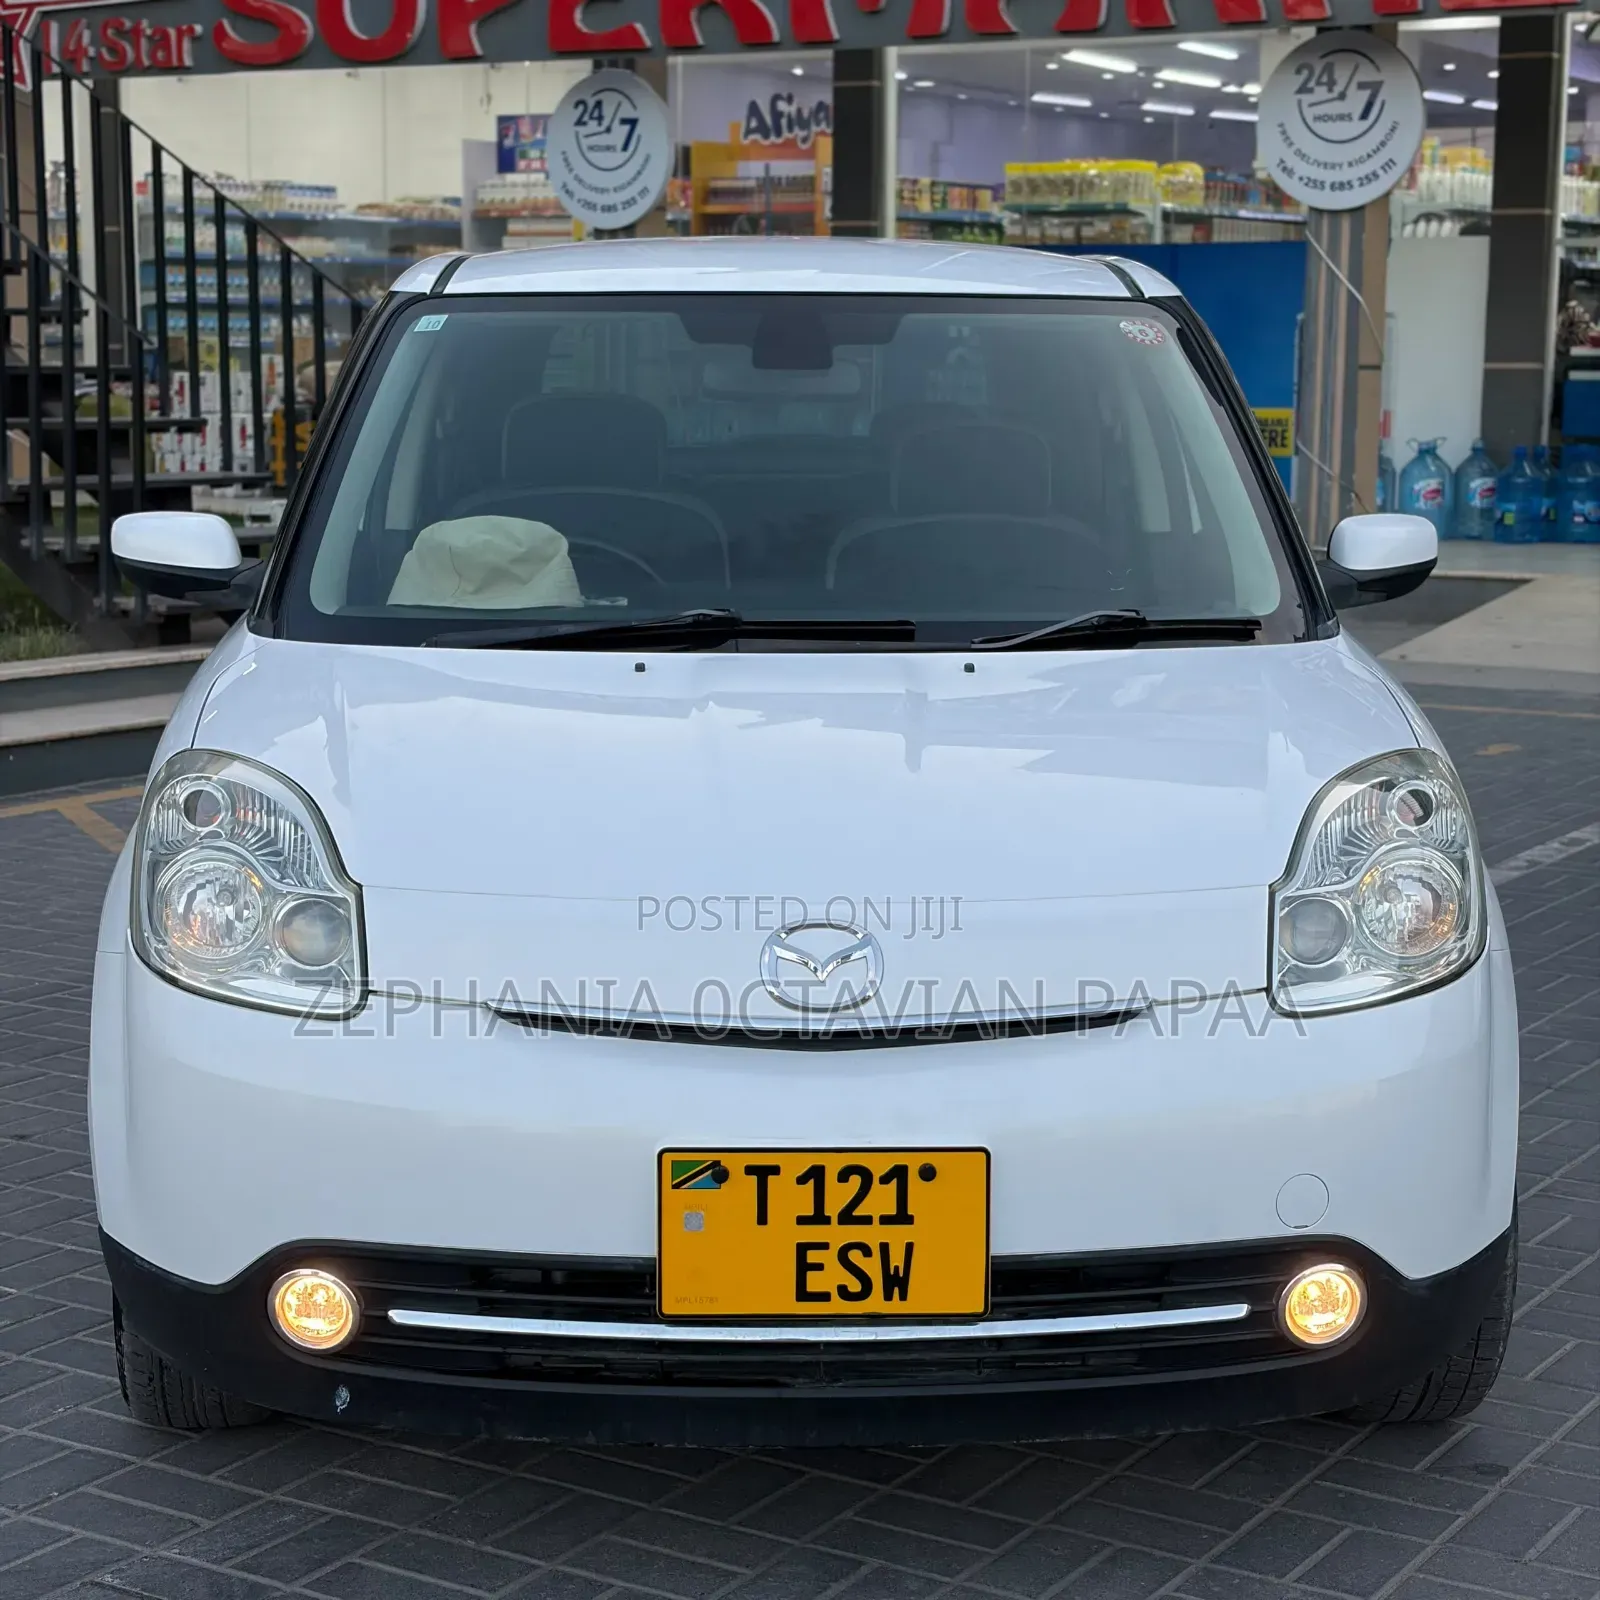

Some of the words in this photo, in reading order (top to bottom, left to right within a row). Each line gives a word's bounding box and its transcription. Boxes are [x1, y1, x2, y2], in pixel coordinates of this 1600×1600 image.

[99, 17, 203, 71] Star
[743, 92, 831, 147] Afiya
[1313, 112, 1353, 123] HOURS
[1277, 121, 1295, 148] FREE
[1293, 148, 1345, 171] DELIVERY
[1298, 174, 1327, 192] +255
[1329, 179, 1354, 192] 685
[1357, 170, 1381, 187] 255
[744, 1164, 781, 1226] T
[795, 1164, 915, 1226] 121
[795, 1241, 914, 1303] ESW
